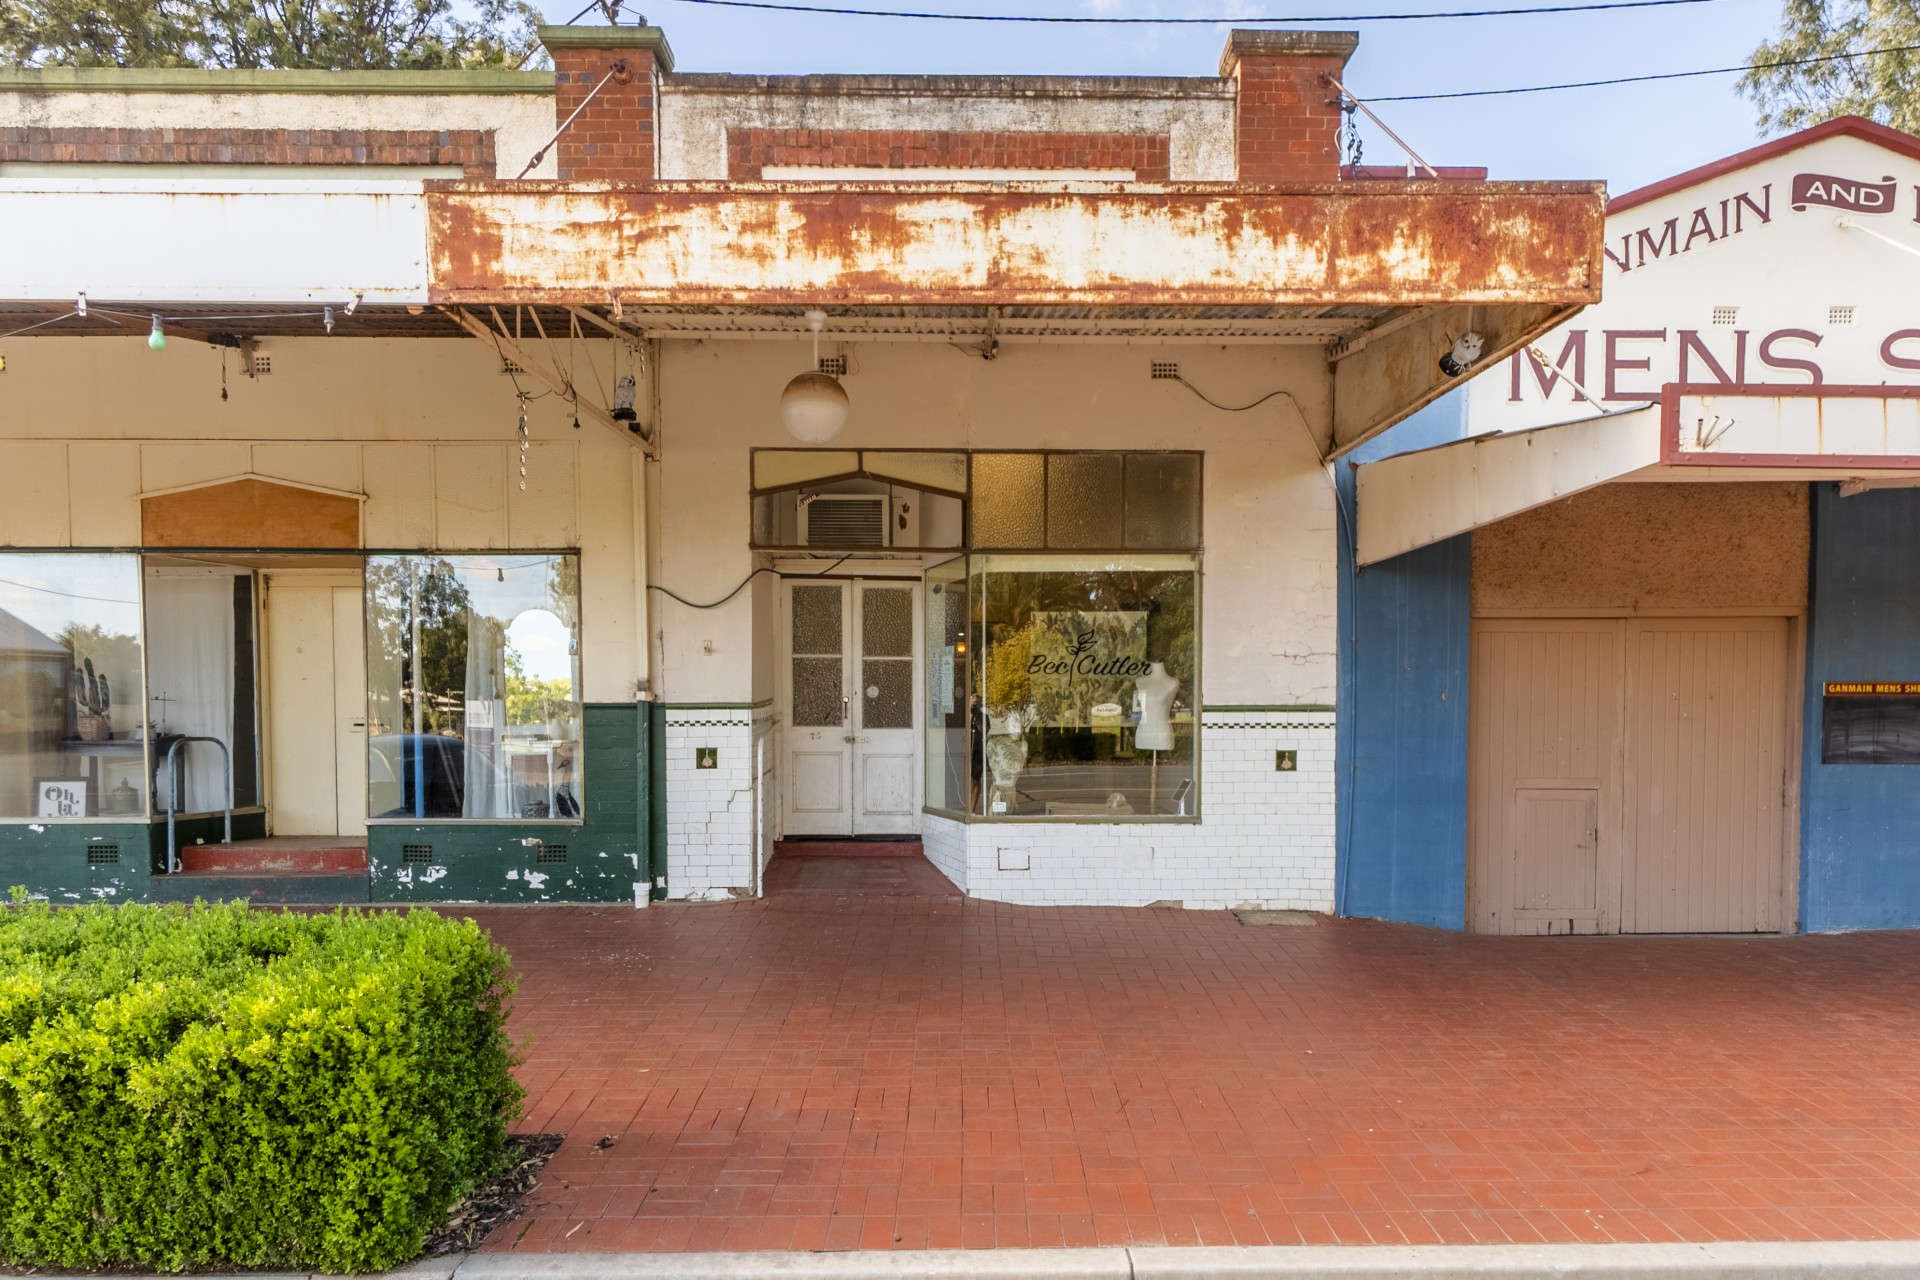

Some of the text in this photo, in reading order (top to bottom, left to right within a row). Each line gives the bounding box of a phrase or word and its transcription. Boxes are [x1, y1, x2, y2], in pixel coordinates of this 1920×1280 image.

[1805, 181, 1884, 206] AND
[1508, 327, 1825, 402] MENS
[1026, 654, 1153, 676] Bec Cutler
[1828, 684, 1873, 693] GANMAIN
[1876, 684, 1902, 693] MENS
[45, 785, 80, 805] Oh
